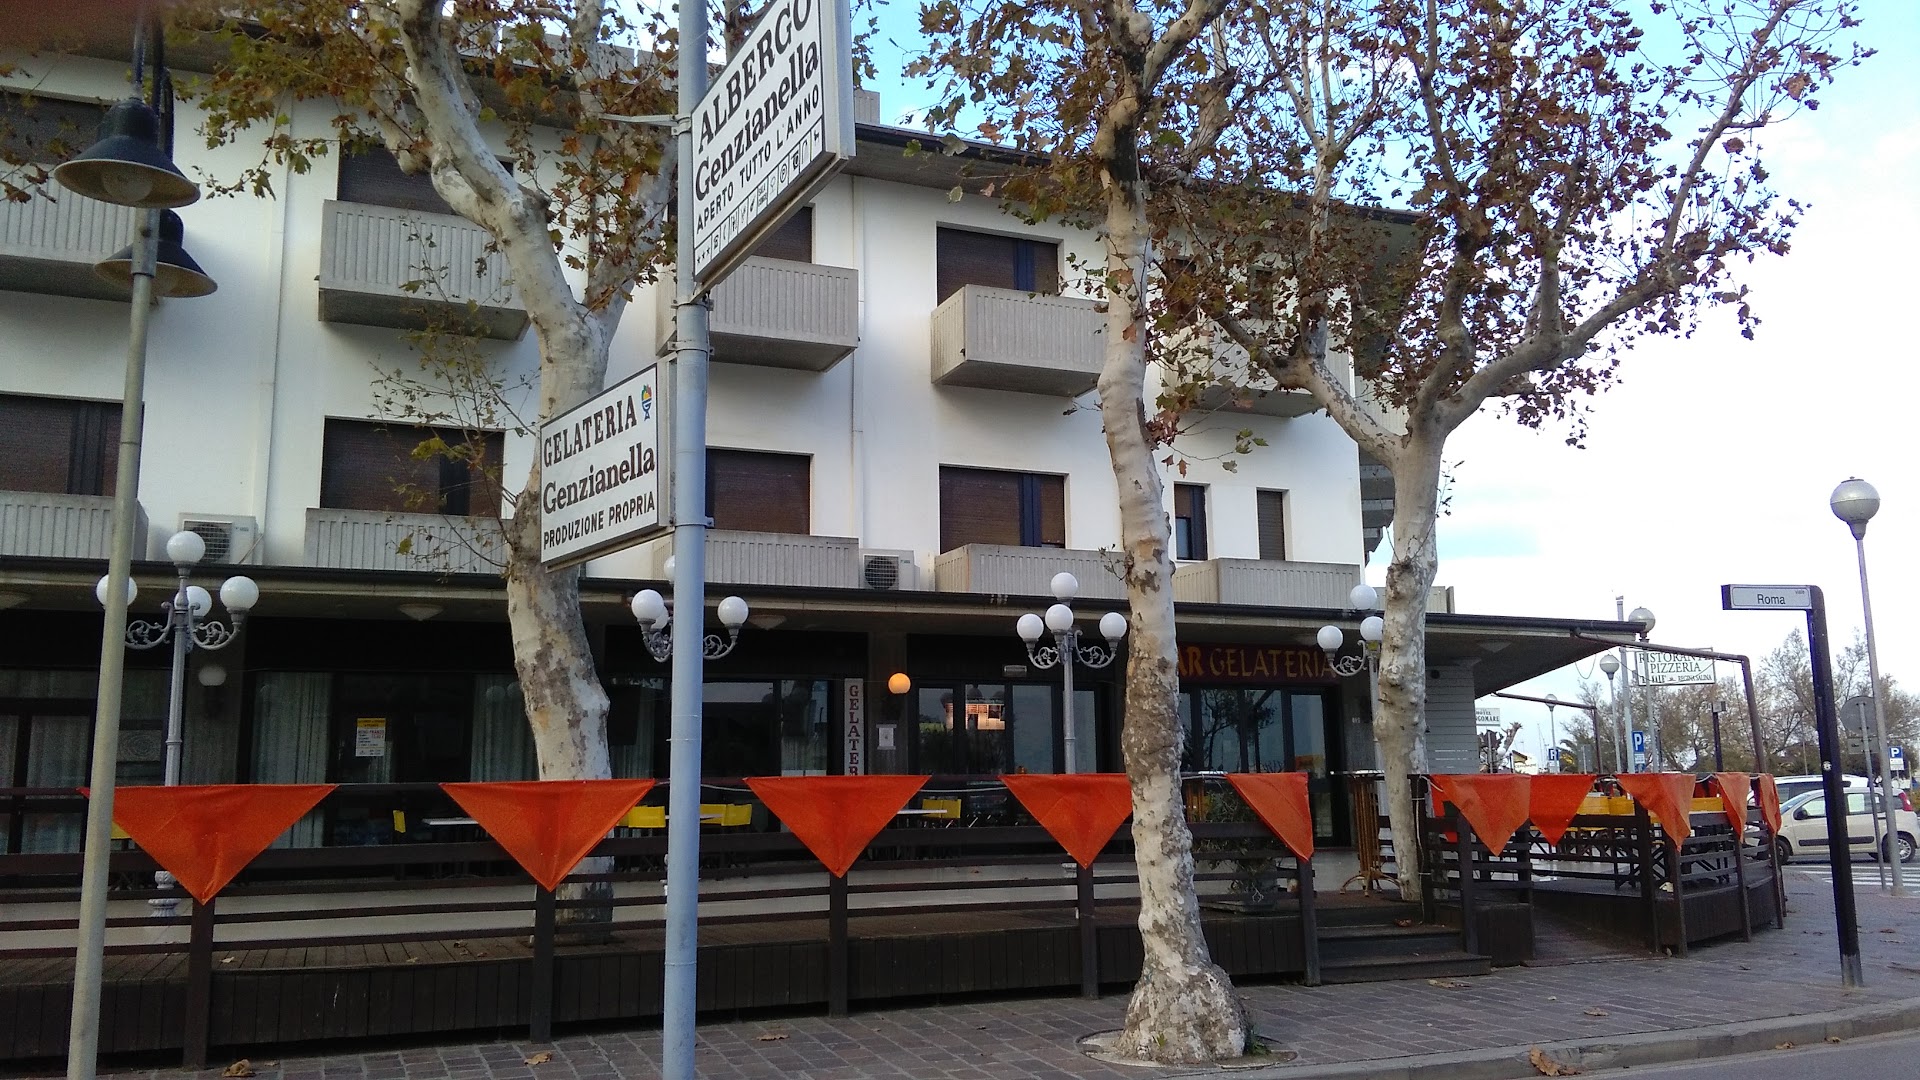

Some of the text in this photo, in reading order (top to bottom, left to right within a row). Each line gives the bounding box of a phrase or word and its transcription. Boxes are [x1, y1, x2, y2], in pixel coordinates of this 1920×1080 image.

[698, 0, 811, 154] ALBERGO
[695, 40, 820, 202] Genzianella
[696, 83, 819, 236] APERTO TUTTO L'ANNO
[543, 394, 638, 468] GELATERIA
[543, 442, 656, 514] Genzianella
[543, 491, 656, 550] PRODUZIONE PROPRIA
[1757, 593, 1786, 605] Roma
[1178, 646, 1336, 678] AR GELATERIA
[1650, 662, 1702, 673] PIZZERIA
[847, 685, 860, 775] GELATER
[1634, 733, 1642, 751] P
[1891, 747, 1900, 758] P
